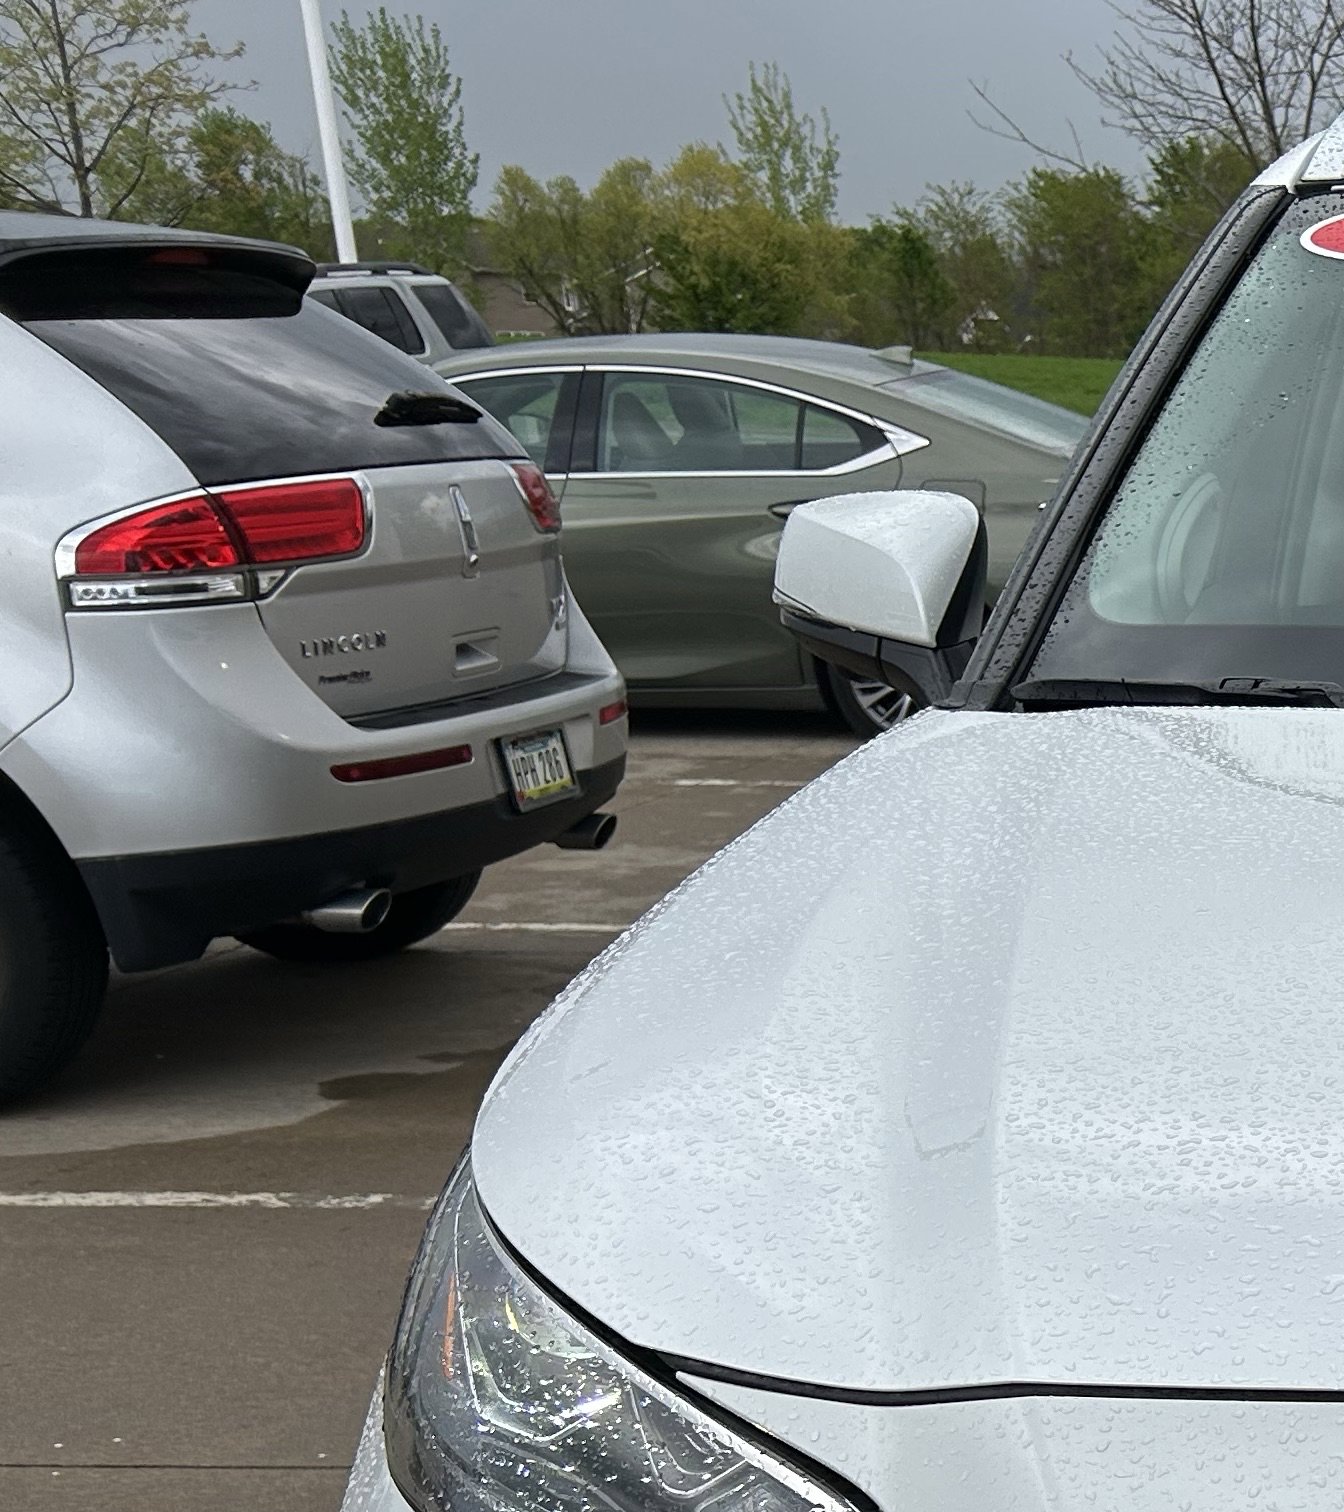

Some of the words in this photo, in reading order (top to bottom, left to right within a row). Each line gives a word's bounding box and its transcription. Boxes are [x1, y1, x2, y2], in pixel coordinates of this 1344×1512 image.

[299, 629, 387, 658] LINCOLN
[511, 753, 541, 791] HPH
[538, 747, 564, 785] 286
